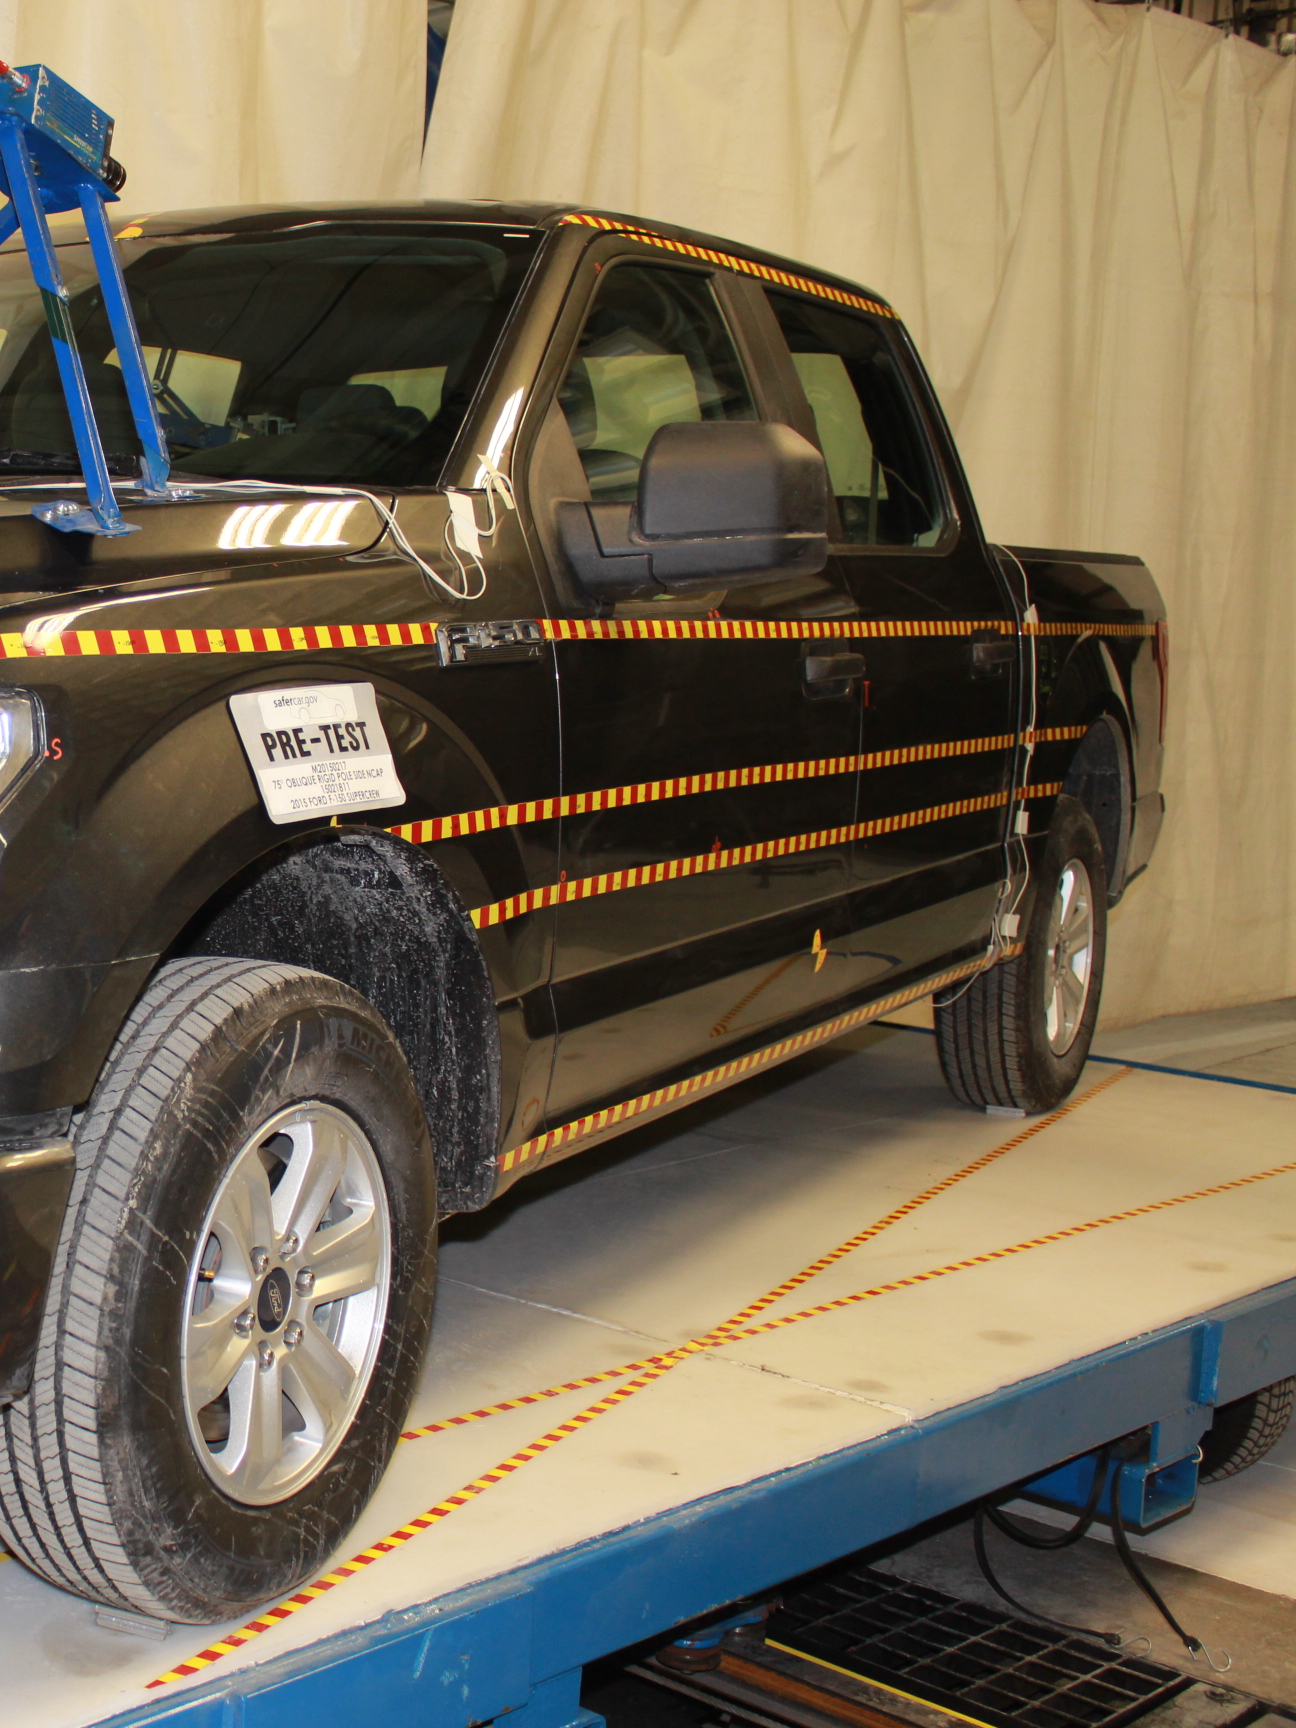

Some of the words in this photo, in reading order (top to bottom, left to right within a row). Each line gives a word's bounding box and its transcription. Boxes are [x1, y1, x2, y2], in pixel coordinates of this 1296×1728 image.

[273, 695, 318, 708] safercar.gov
[260, 721, 370, 762] PRE-TEST
[285, 775, 317, 788] OBLIQUE
[317, 772, 336, 784] RIGID
[336, 771, 353, 781] POLE
[353, 769, 366, 780] SIDE
[366, 768, 383, 779] NCAP
[291, 797, 308, 809] 2015
[308, 795, 328, 807] FORD
[328, 793, 347, 804] F-150
[346, 789, 381, 802] SUPERCREW
[270, 1288, 282, 1315] Ford
